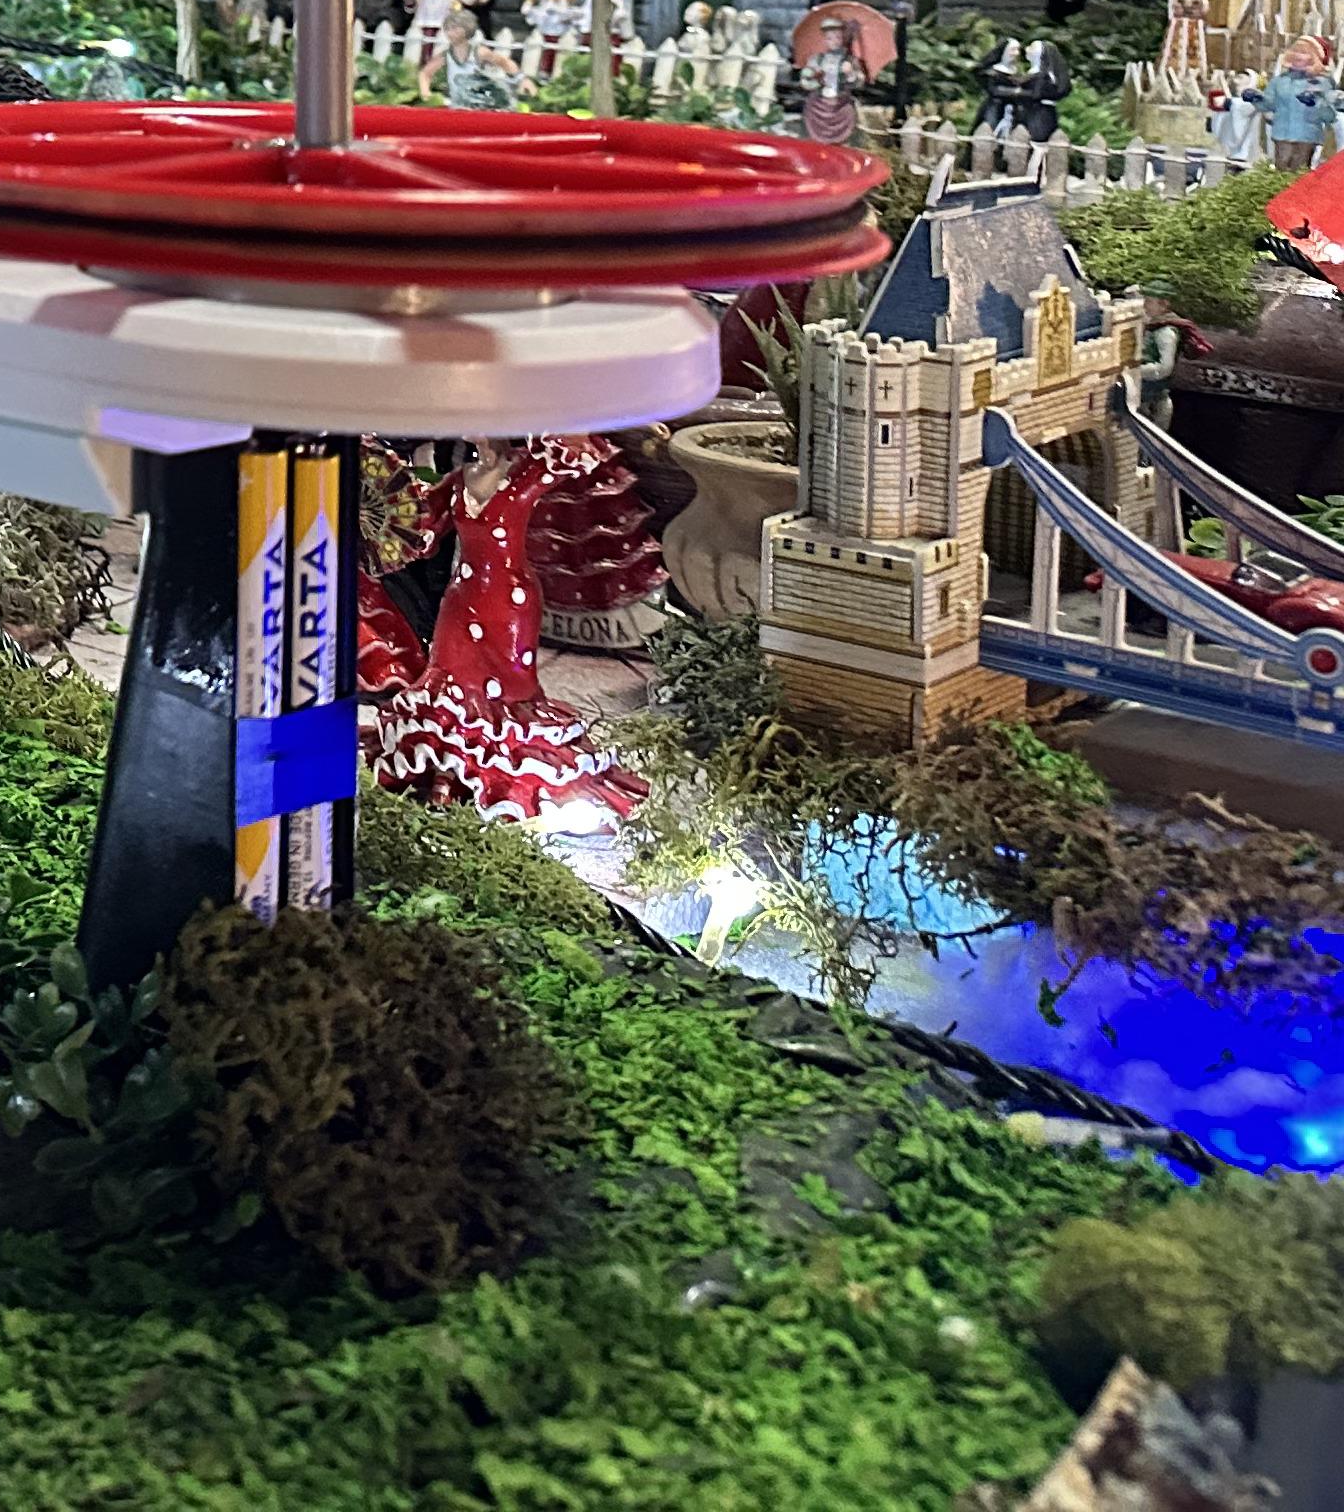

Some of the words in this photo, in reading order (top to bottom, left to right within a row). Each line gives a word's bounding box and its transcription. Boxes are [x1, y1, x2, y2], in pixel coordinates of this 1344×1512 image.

[259, 537, 284, 716] VARTA
[296, 539, 328, 710] VARTA
[542, 610, 631, 643] ELONA
